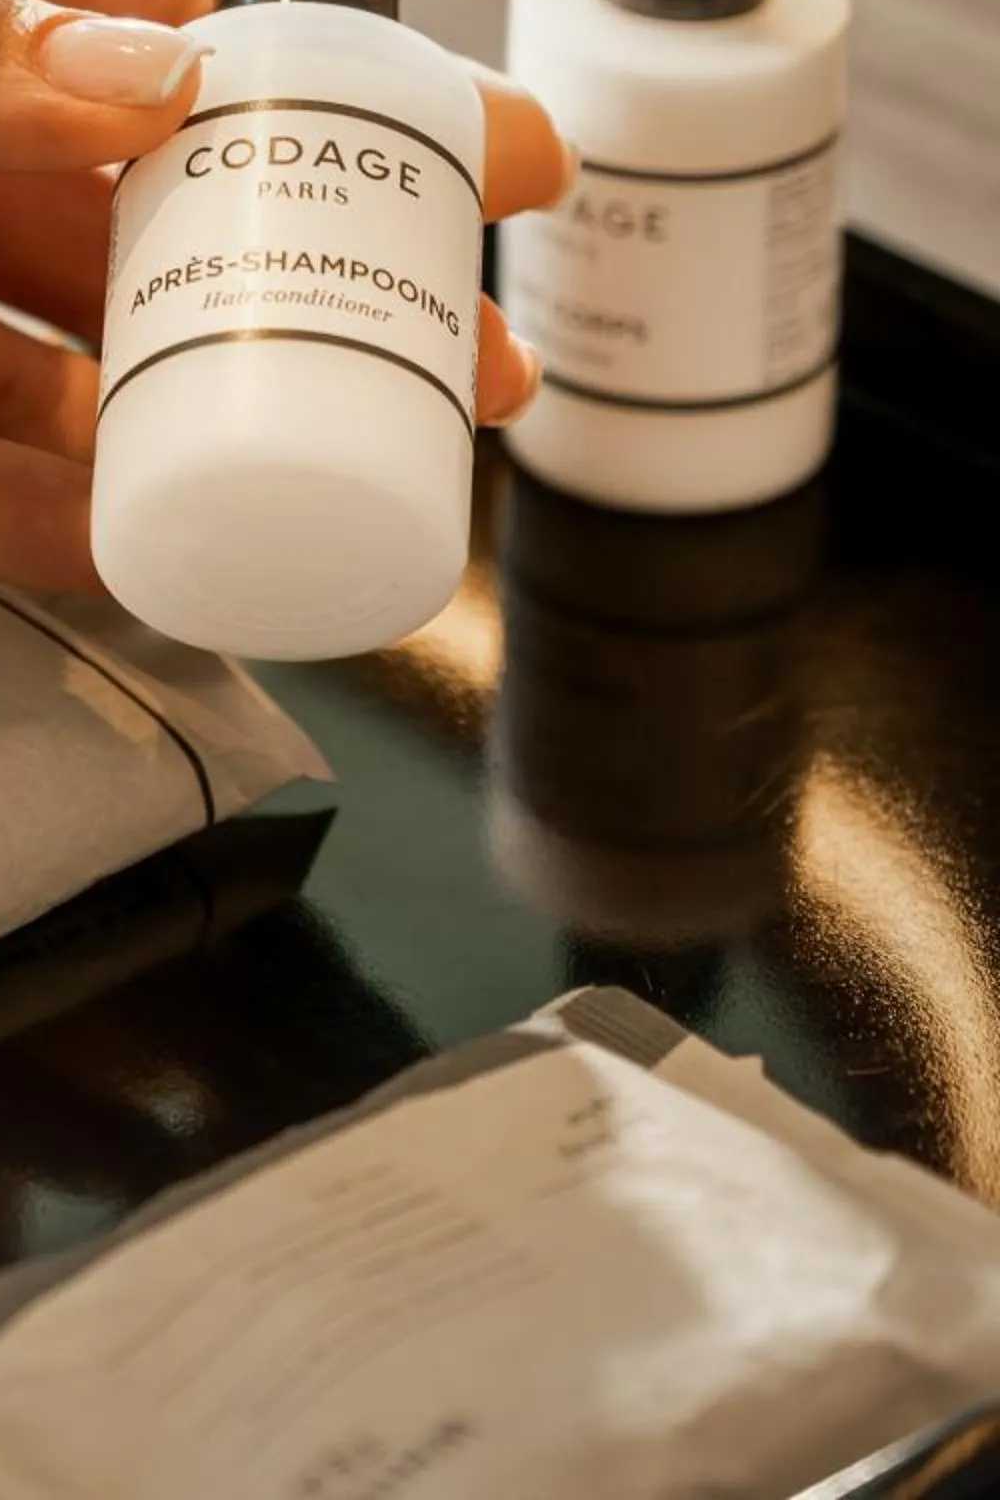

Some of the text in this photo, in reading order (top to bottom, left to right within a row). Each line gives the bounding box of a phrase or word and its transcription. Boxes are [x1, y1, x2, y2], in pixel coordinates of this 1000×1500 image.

[185, 136, 421, 198] CODAGE
[256, 180, 351, 205] PARIS
[569, 192, 669, 243] AGE
[129, 249, 461, 337] APRÈS-SHAMPOOING
[261, 288, 395, 323] conditioner
